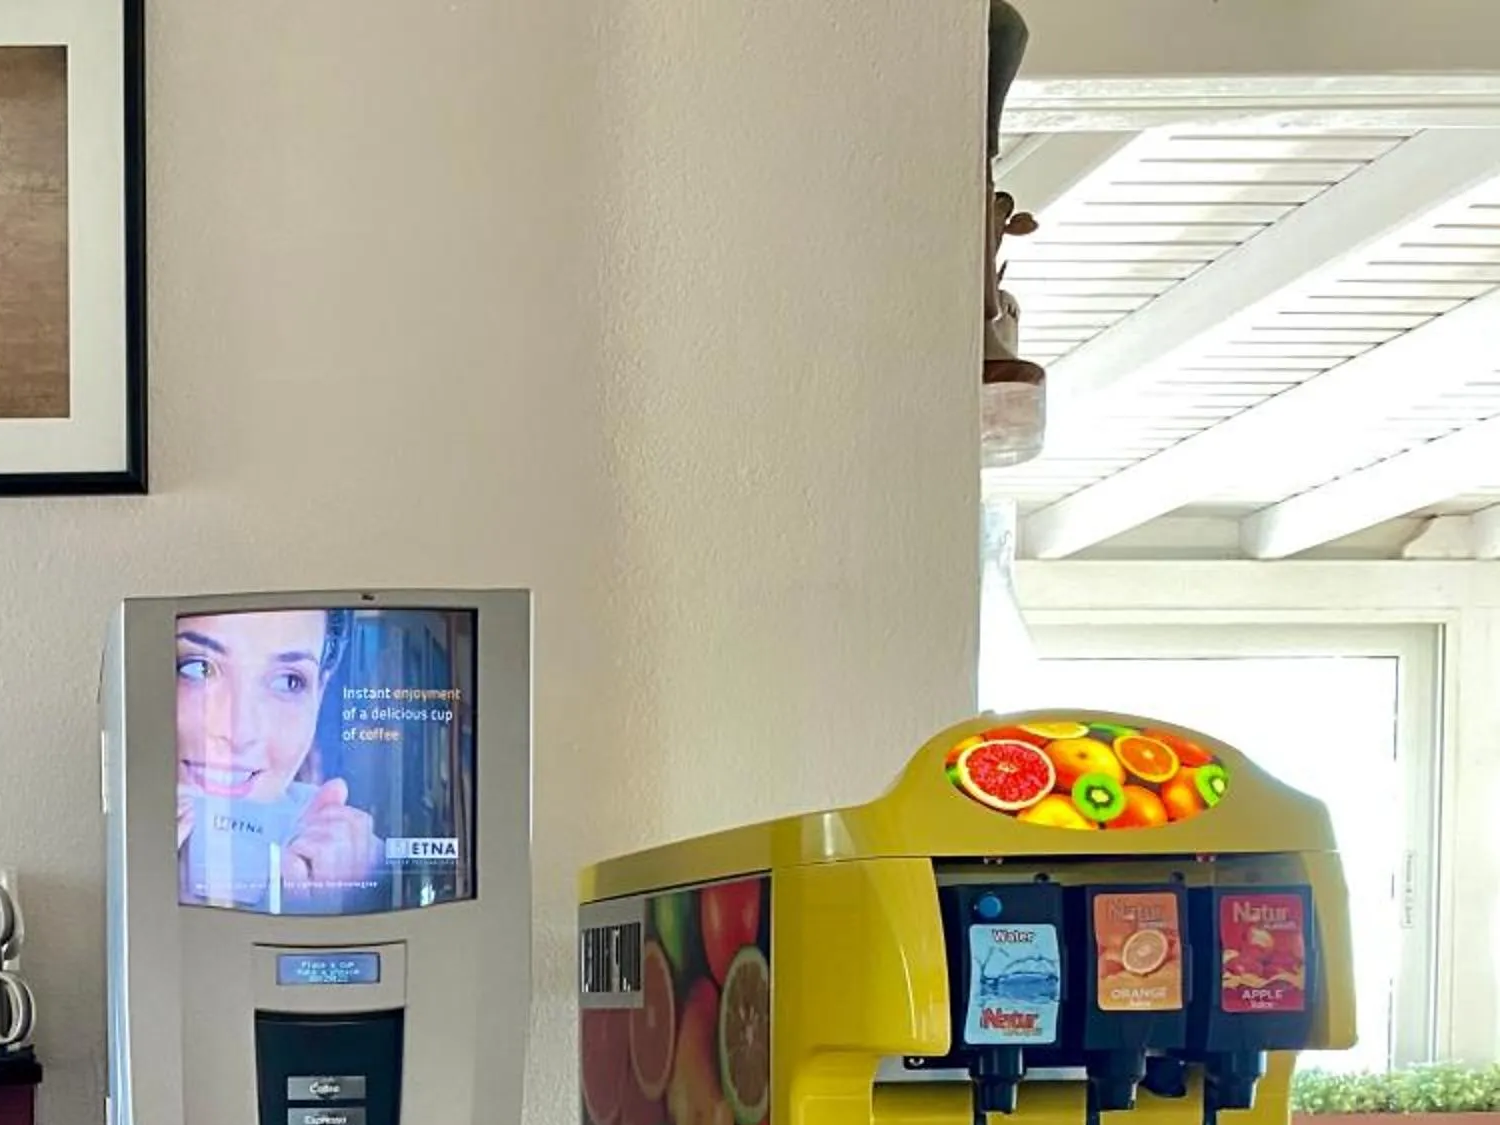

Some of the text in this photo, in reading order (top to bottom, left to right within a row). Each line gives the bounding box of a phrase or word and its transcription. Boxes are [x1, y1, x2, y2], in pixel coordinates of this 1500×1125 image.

[342, 686, 463, 703] Instant enjoyment
[342, 706, 454, 724] of a delicious cup
[342, 726, 400, 741] of coffee
[411, 840, 457, 857] ETNA
[1232, 901, 1289, 923] Natur
[991, 928, 1037, 944] Water
[1110, 986, 1168, 1000] ORANGE
[1241, 989, 1284, 1000] APPLE
[980, 1006, 1040, 1030] Natur
